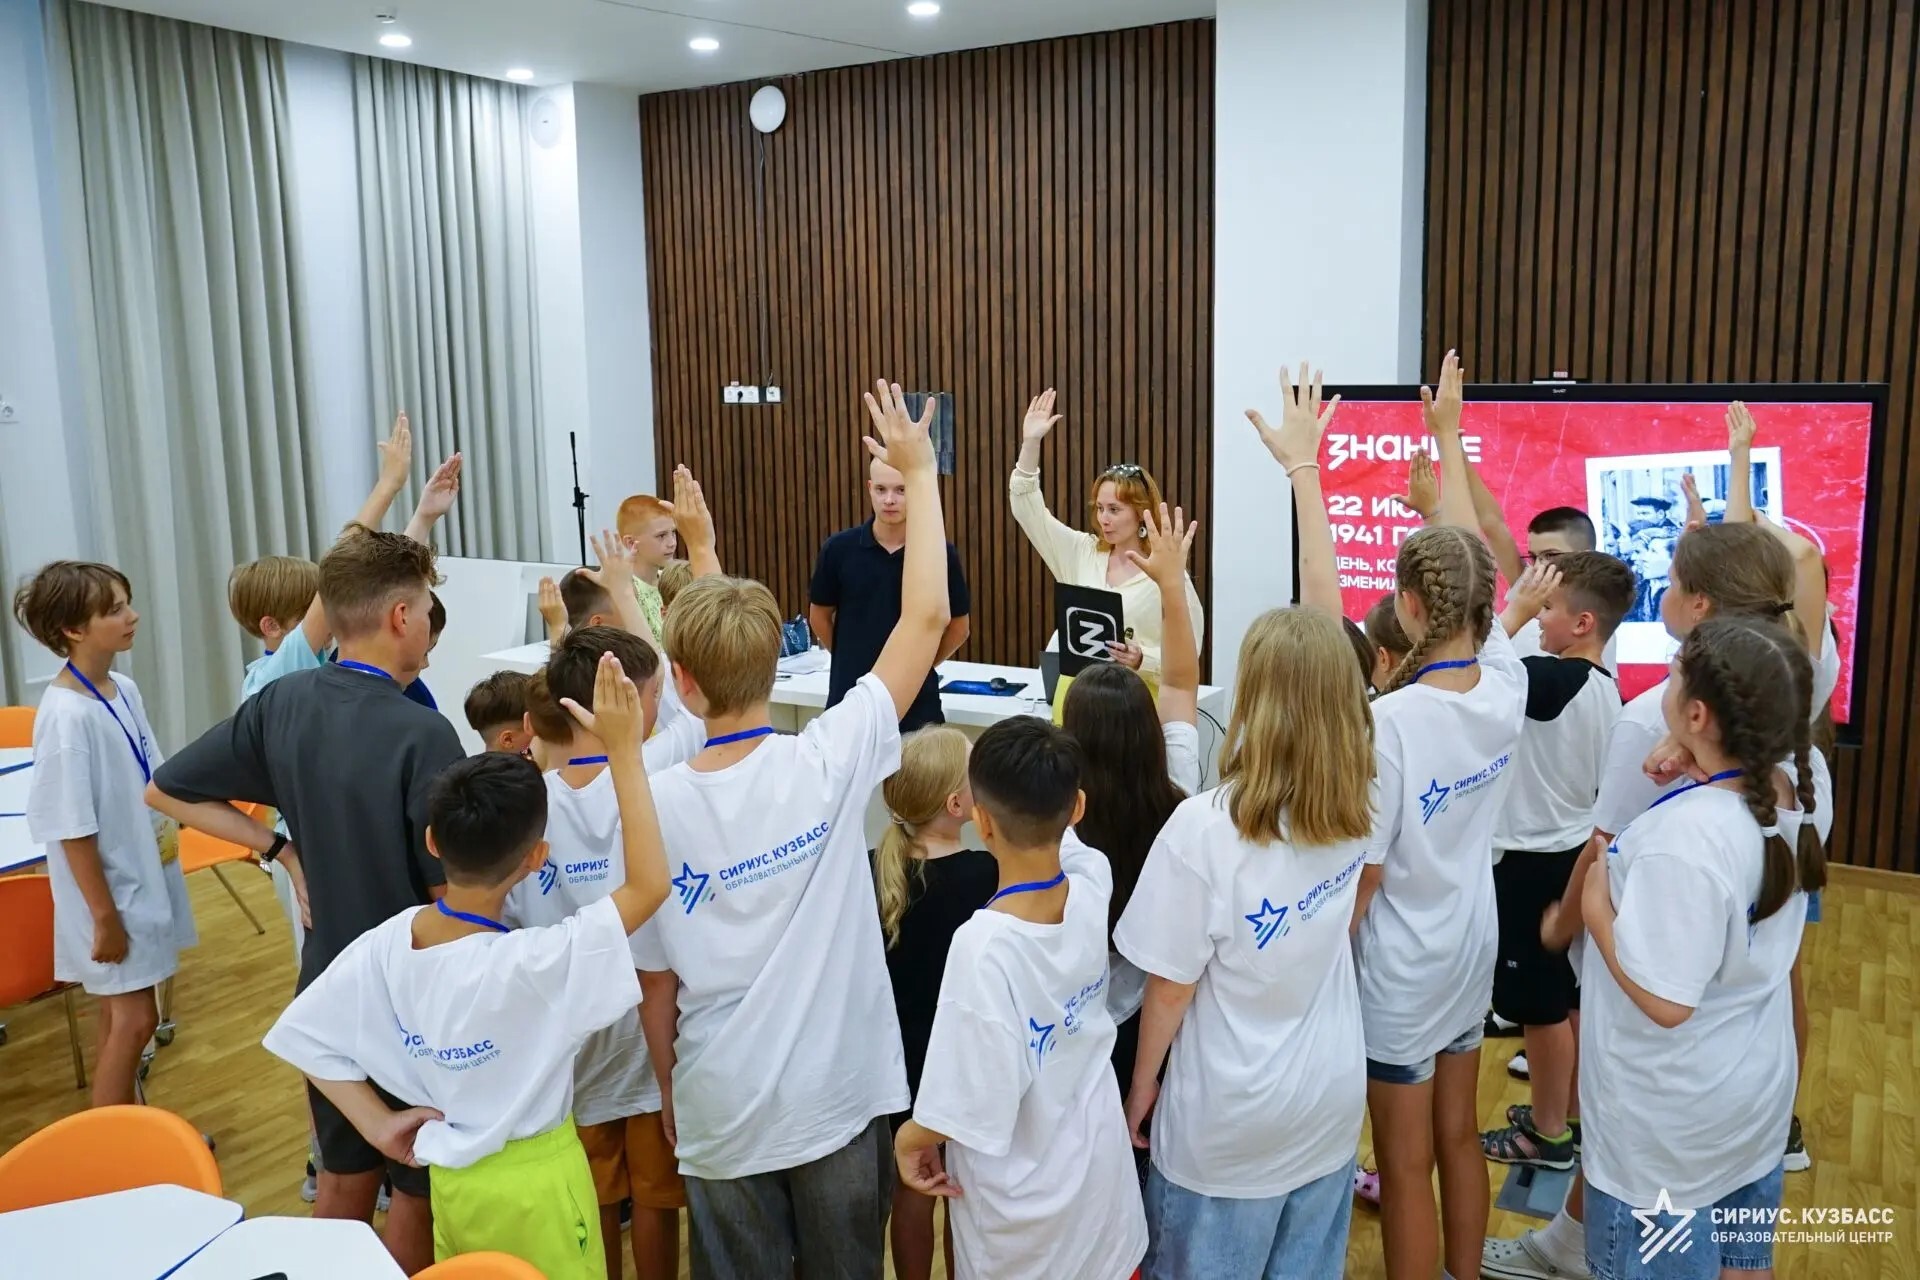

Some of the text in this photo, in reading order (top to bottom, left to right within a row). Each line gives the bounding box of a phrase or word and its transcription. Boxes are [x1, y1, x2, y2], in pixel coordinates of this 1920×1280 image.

[1328, 495, 1363, 516] 22
[719, 821, 830, 881] СИРИУС. КУЗБАСС
[725, 851, 809, 891] ОБРАЗОВАТЕЛЬНЫЙ
